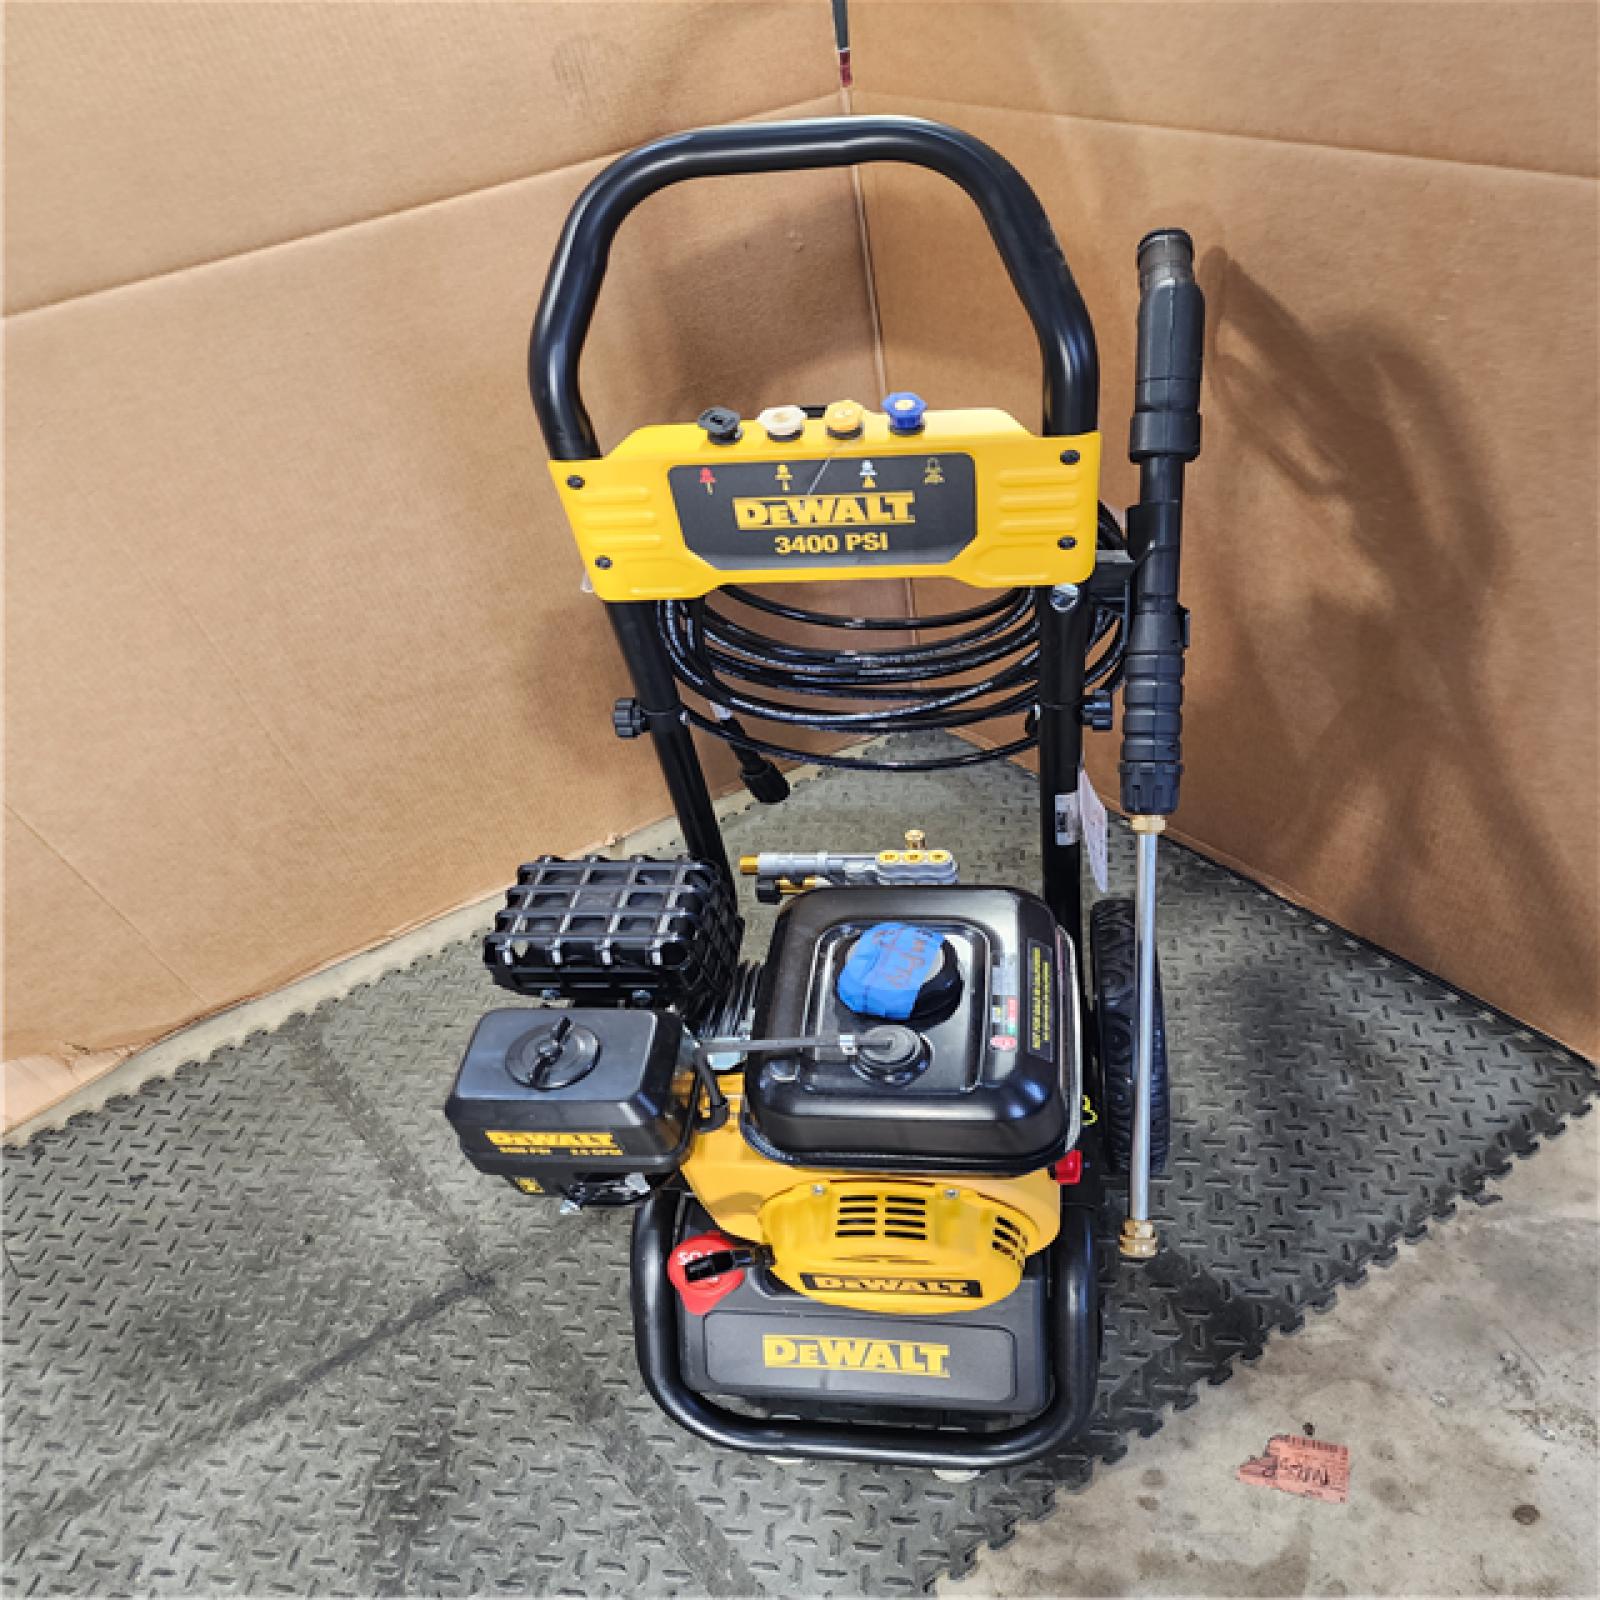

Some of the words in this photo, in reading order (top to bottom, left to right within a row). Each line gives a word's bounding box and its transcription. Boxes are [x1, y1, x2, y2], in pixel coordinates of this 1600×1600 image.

[733, 491, 916, 530] DEWALT
[775, 534, 838, 554] 3400
[844, 532, 888, 552] PSI
[813, 1276, 969, 1295] DEWALT
[763, 1335, 950, 1377] DEWALT
